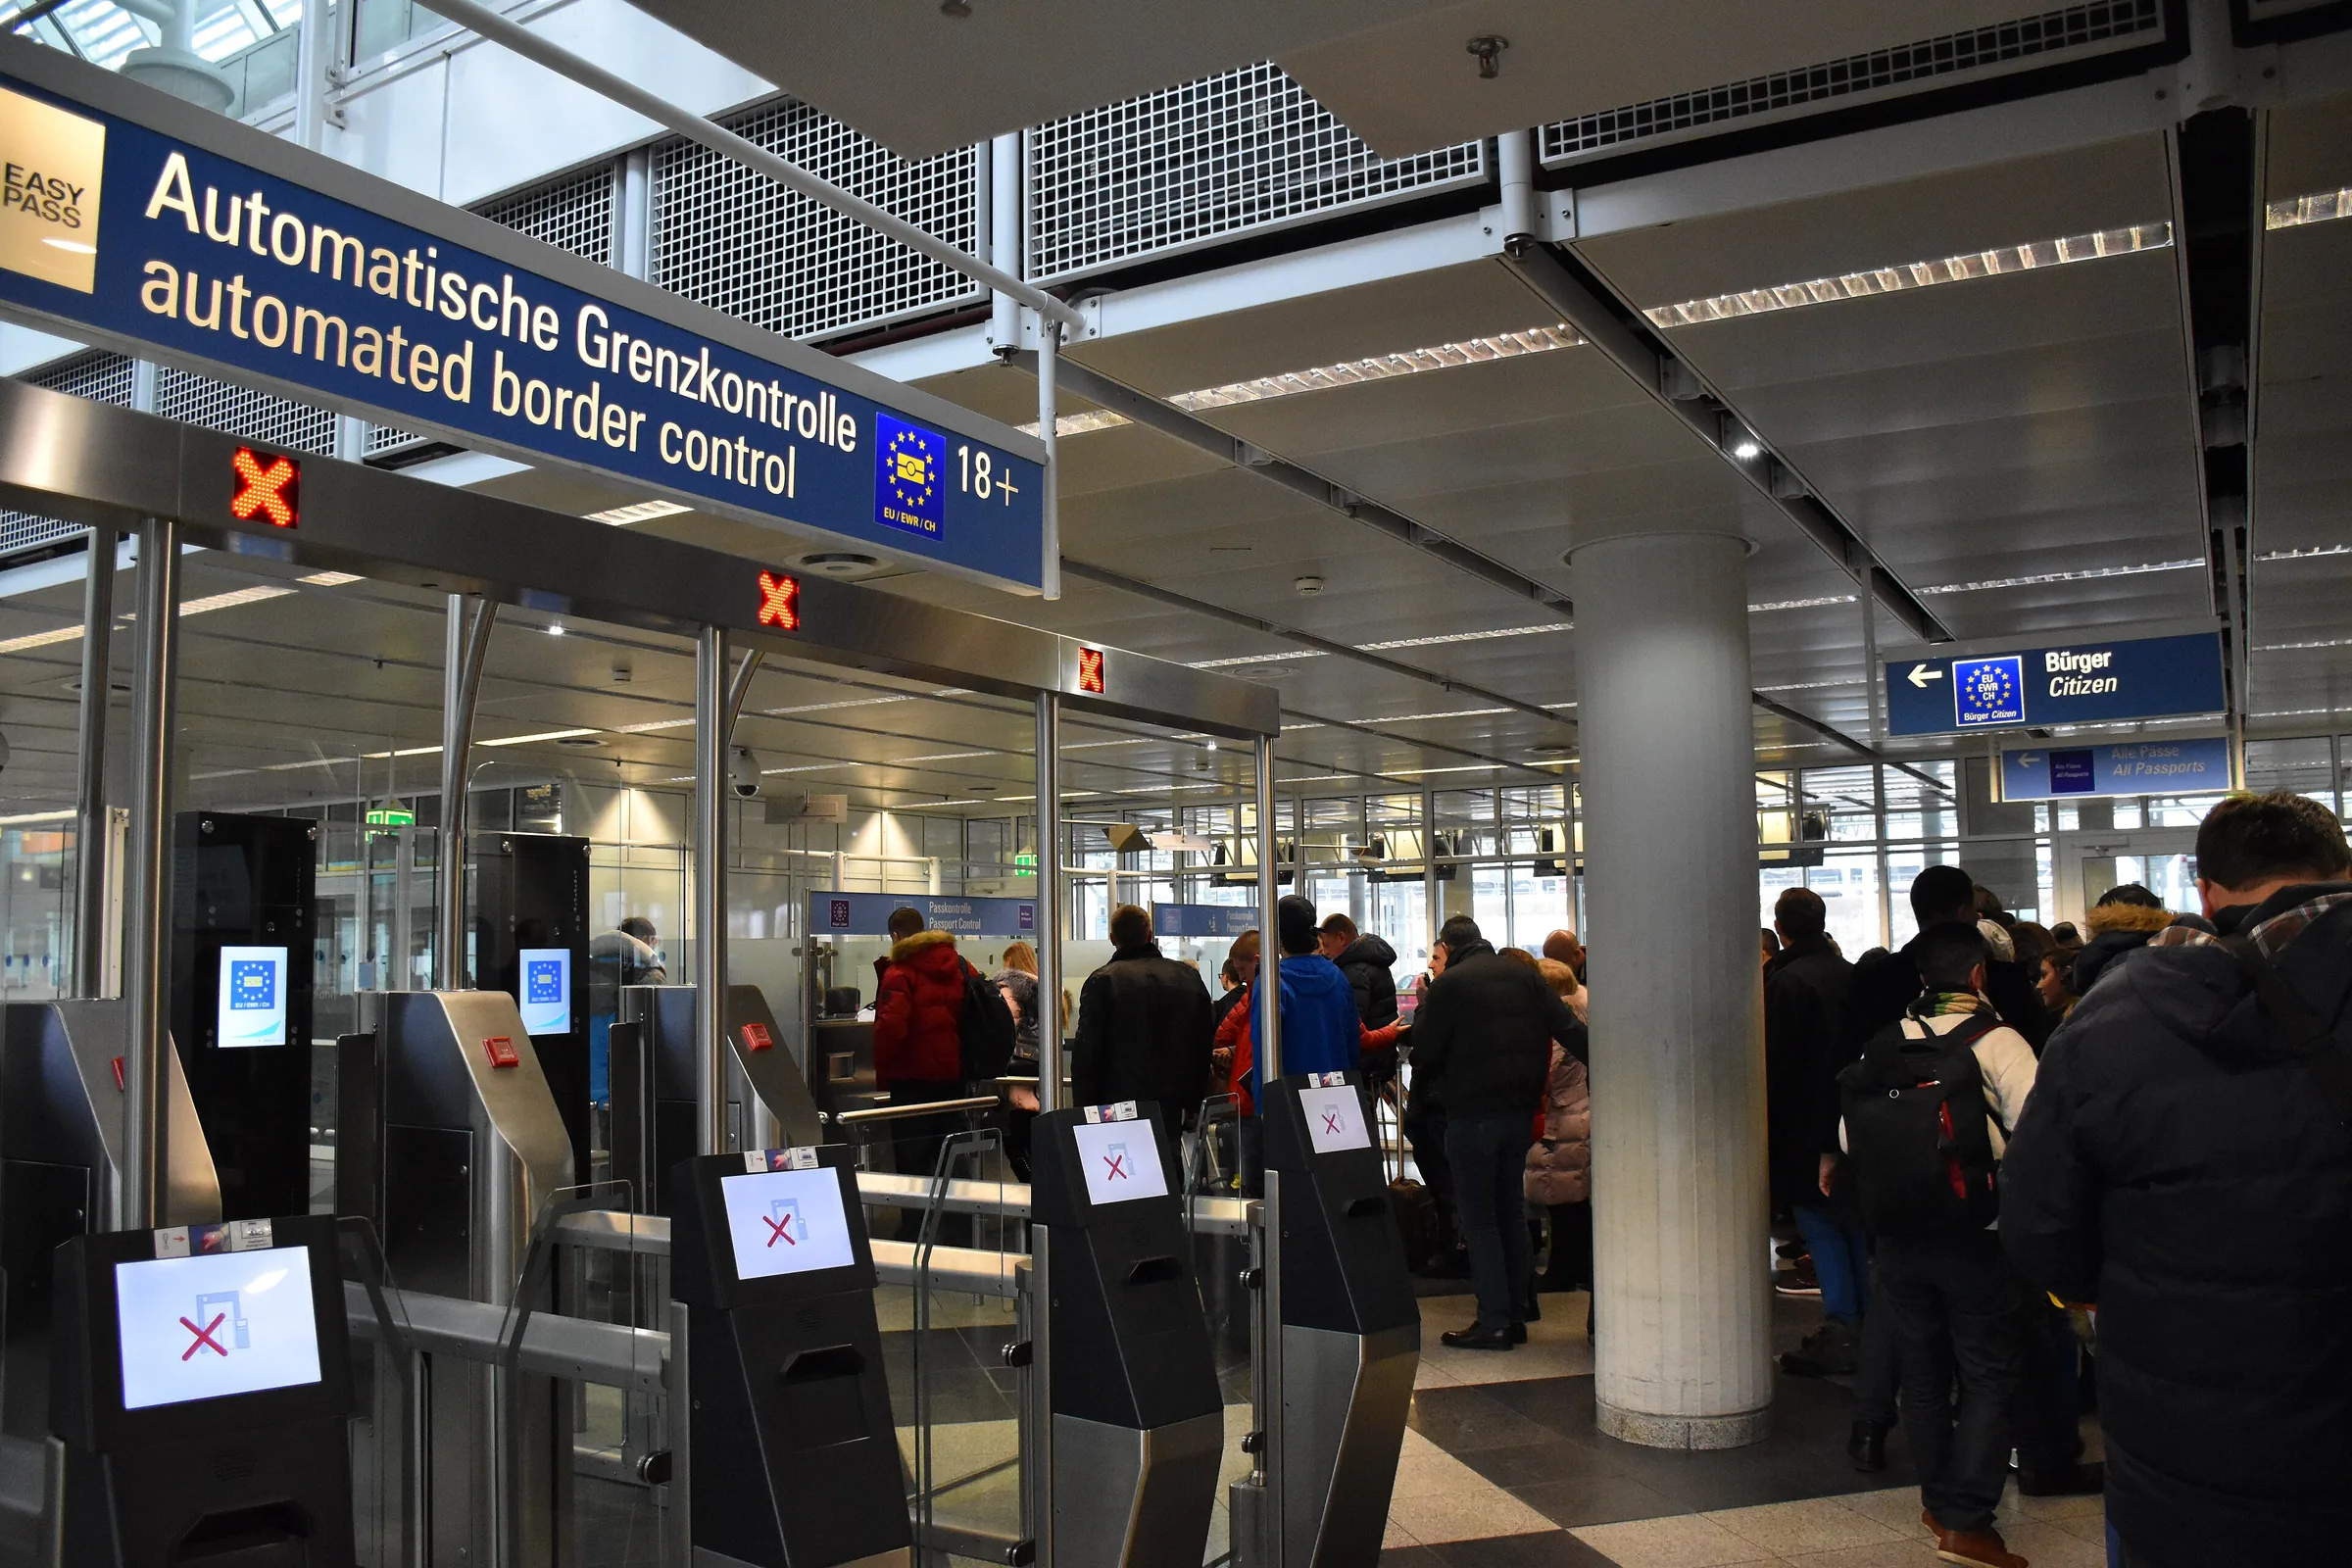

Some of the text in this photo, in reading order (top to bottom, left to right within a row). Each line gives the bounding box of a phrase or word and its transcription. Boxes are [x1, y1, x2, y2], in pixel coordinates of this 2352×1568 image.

[4, 161, 85, 206] EASY
[3, 184, 81, 229] PASS
[145, 152, 858, 453] Automatische Grenzkontrolle
[140, 259, 796, 499] automated border control
[957, 446, 1018, 507] 18+
[884, 506, 896, 519] EU
[901, 512, 919, 527] EWR
[924, 519, 936, 532] CH
[2045, 652, 2112, 673] Bürger
[1978, 682, 1998, 692] EWR
[1982, 673, 1993, 683] EU
[2049, 674, 2117, 697] Citizen
[1983, 691, 1995, 701] CH
[1963, 710, 2017, 721] Bürger Citizen
[2111, 744, 2180, 760] Alle Pässe
[2113, 760, 2205, 777] All Passports
[929, 901, 972, 914] Passkontrolle
[929, 916, 981, 931] Passport Control
